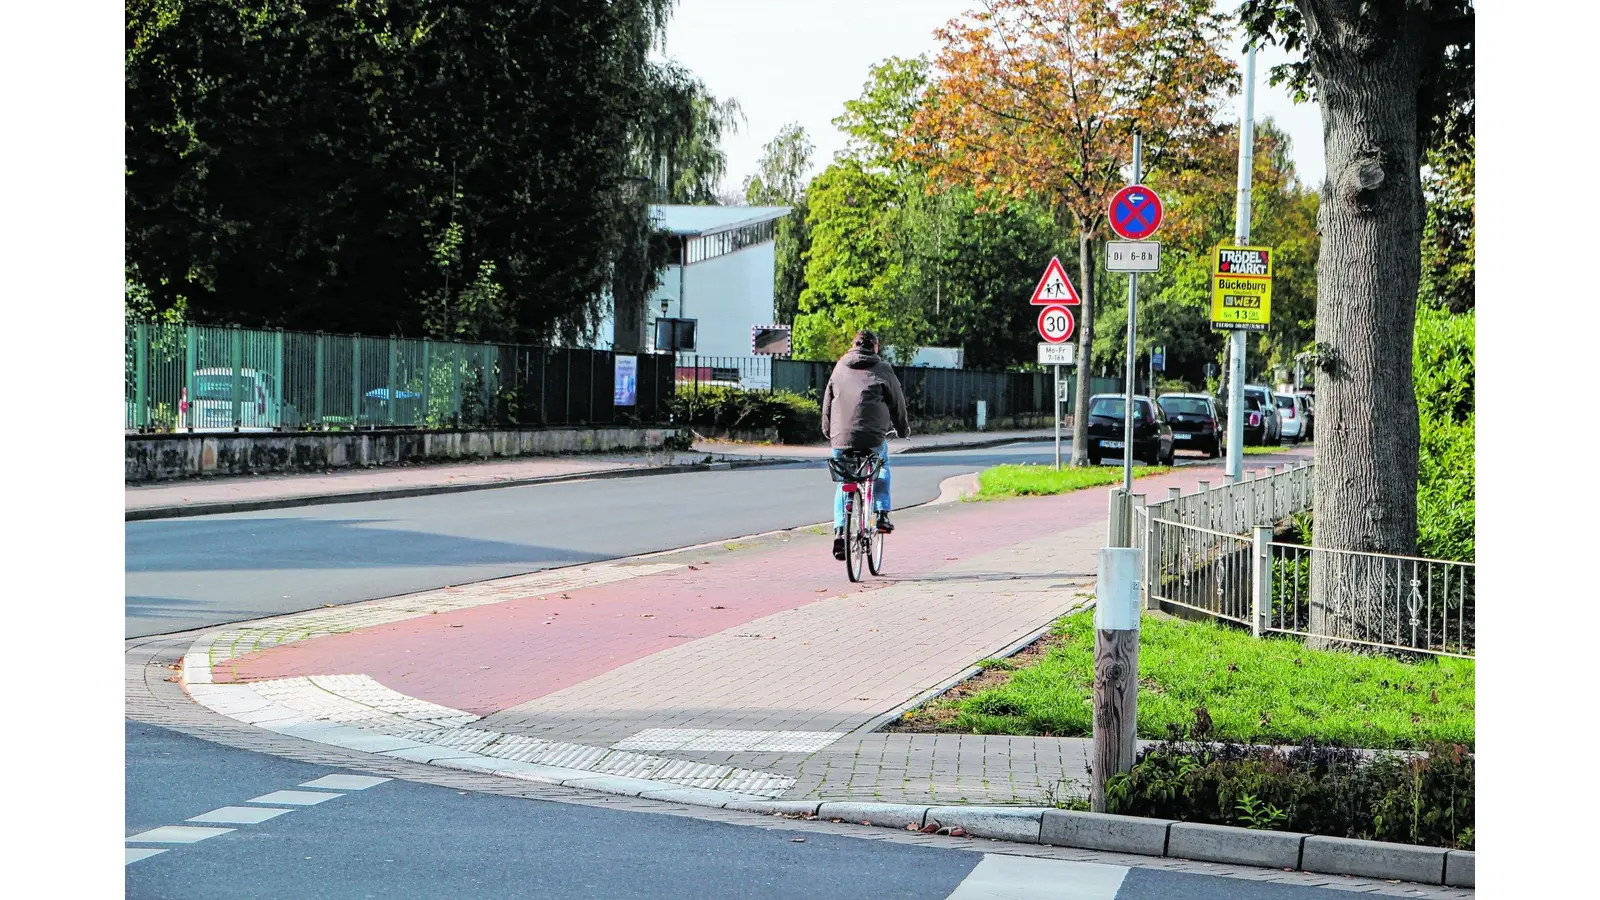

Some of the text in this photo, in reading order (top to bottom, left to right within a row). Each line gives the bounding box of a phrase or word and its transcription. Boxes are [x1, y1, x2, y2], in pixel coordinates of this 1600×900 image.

[1131, 252, 1146, 260] 6-8
[1220, 250, 1262, 264] TRÖDEL
[1230, 263, 1267, 274] MARKT
[1219, 279, 1266, 293] Bückeburg
[1234, 297, 1259, 307] WEZ
[1046, 316, 1066, 332] 30
